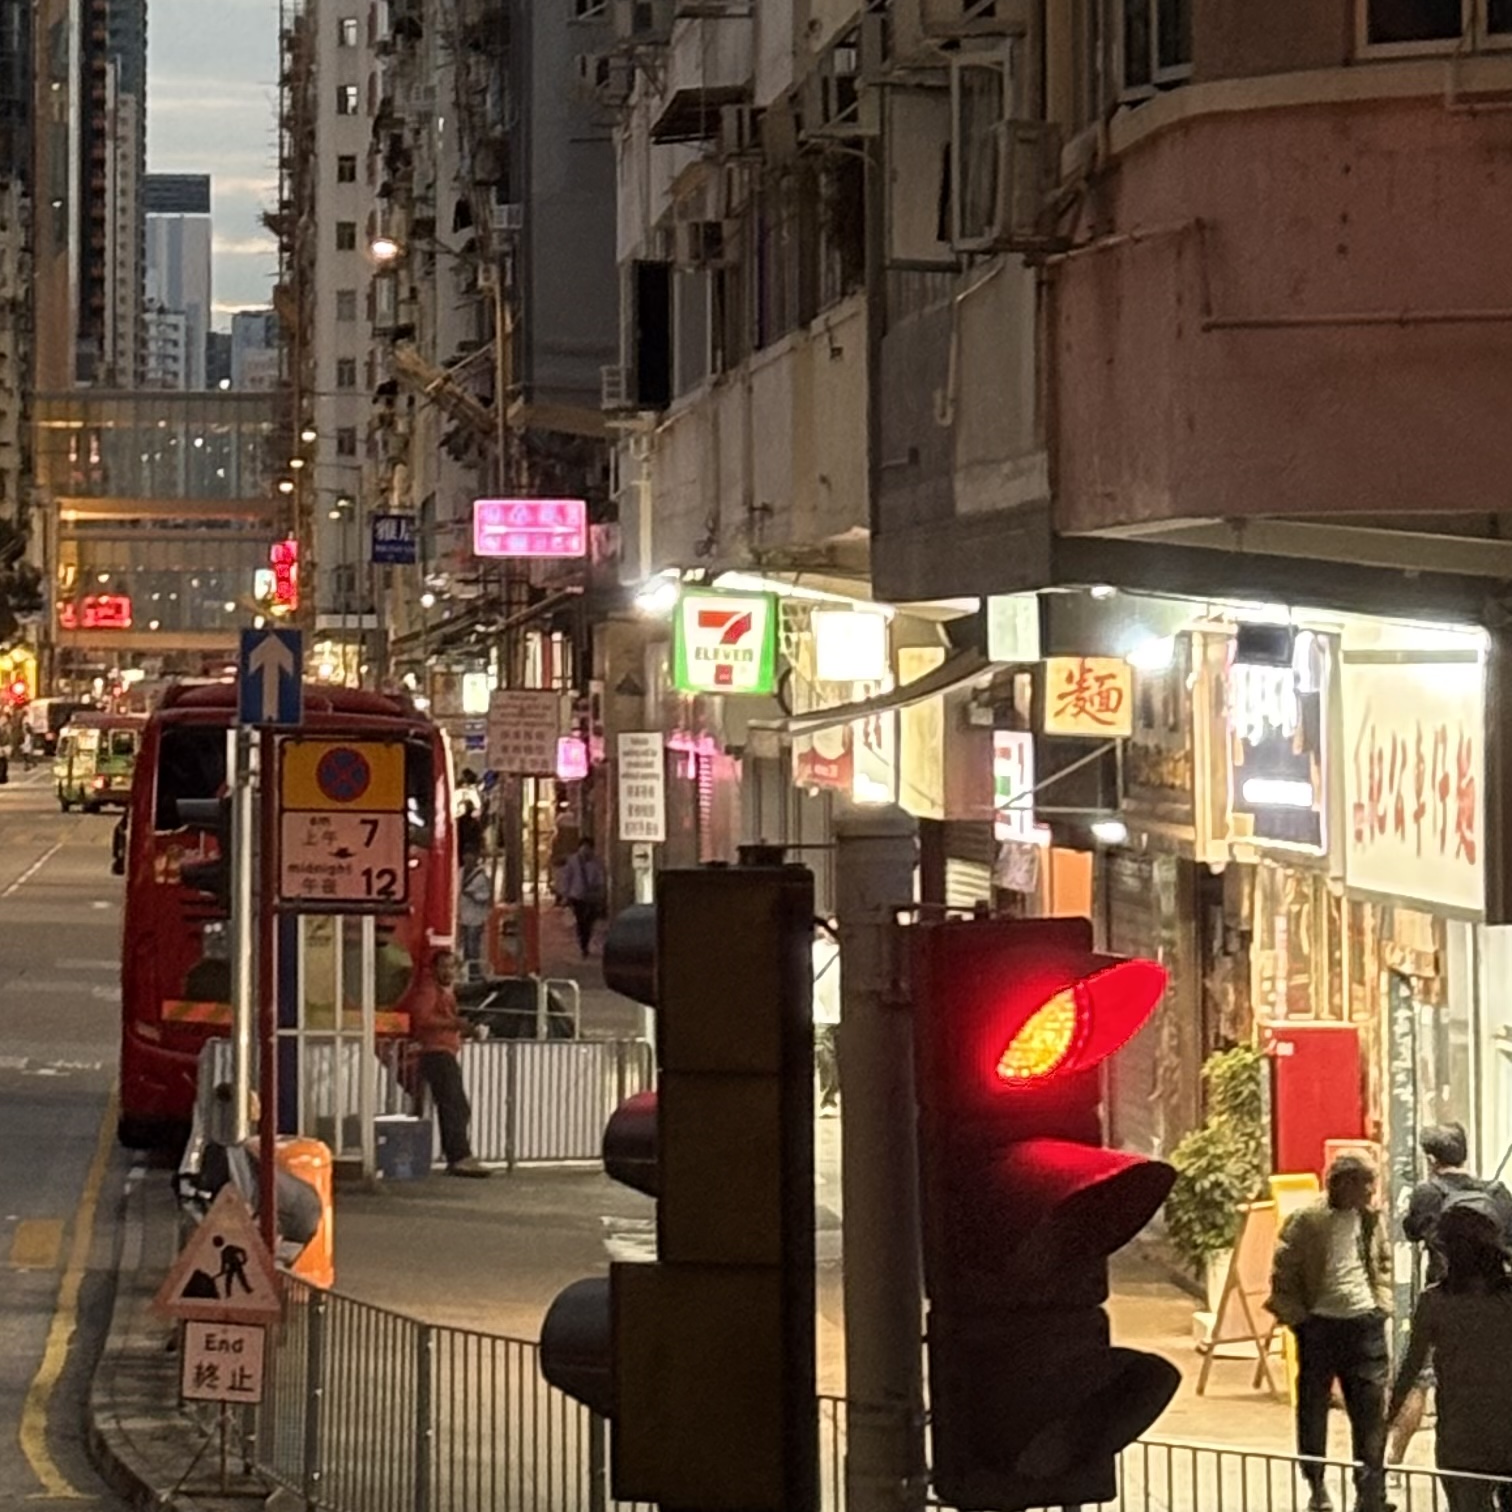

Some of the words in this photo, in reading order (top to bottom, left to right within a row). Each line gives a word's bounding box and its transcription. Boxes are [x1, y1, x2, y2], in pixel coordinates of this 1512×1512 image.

[1053, 658, 1124, 727] 麵
[359, 818, 379, 848] 7
[287, 863, 352, 876] midnight
[361, 866, 397, 897] 12
[205, 1332, 245, 1354] End
[193, 1361, 255, 1393] 終止
